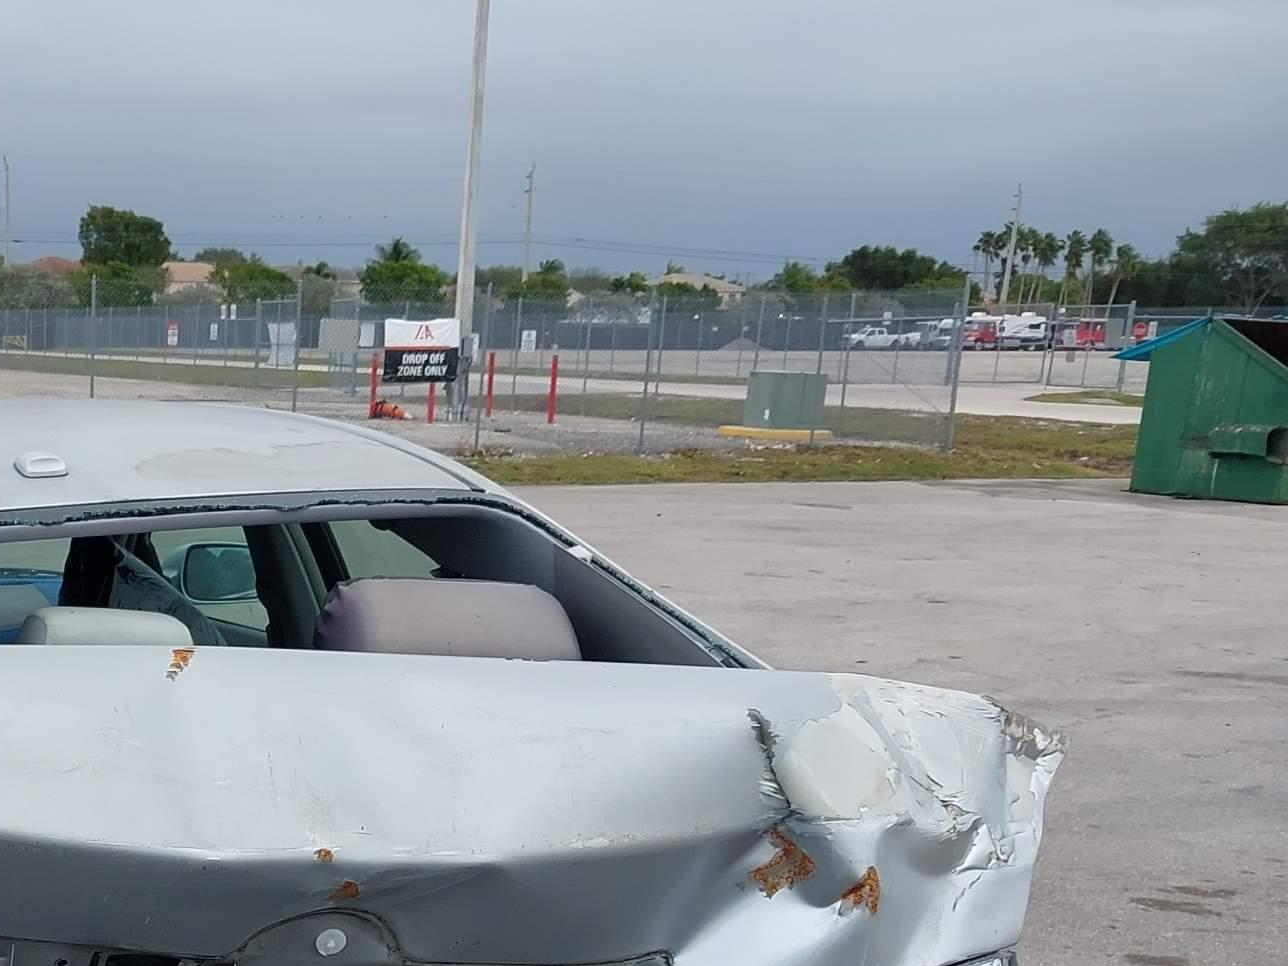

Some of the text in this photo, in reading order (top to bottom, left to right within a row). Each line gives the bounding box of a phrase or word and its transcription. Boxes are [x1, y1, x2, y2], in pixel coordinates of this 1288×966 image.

[402, 352, 446, 365] DROP OFF
[397, 364, 448, 377] ZONE ONLY
